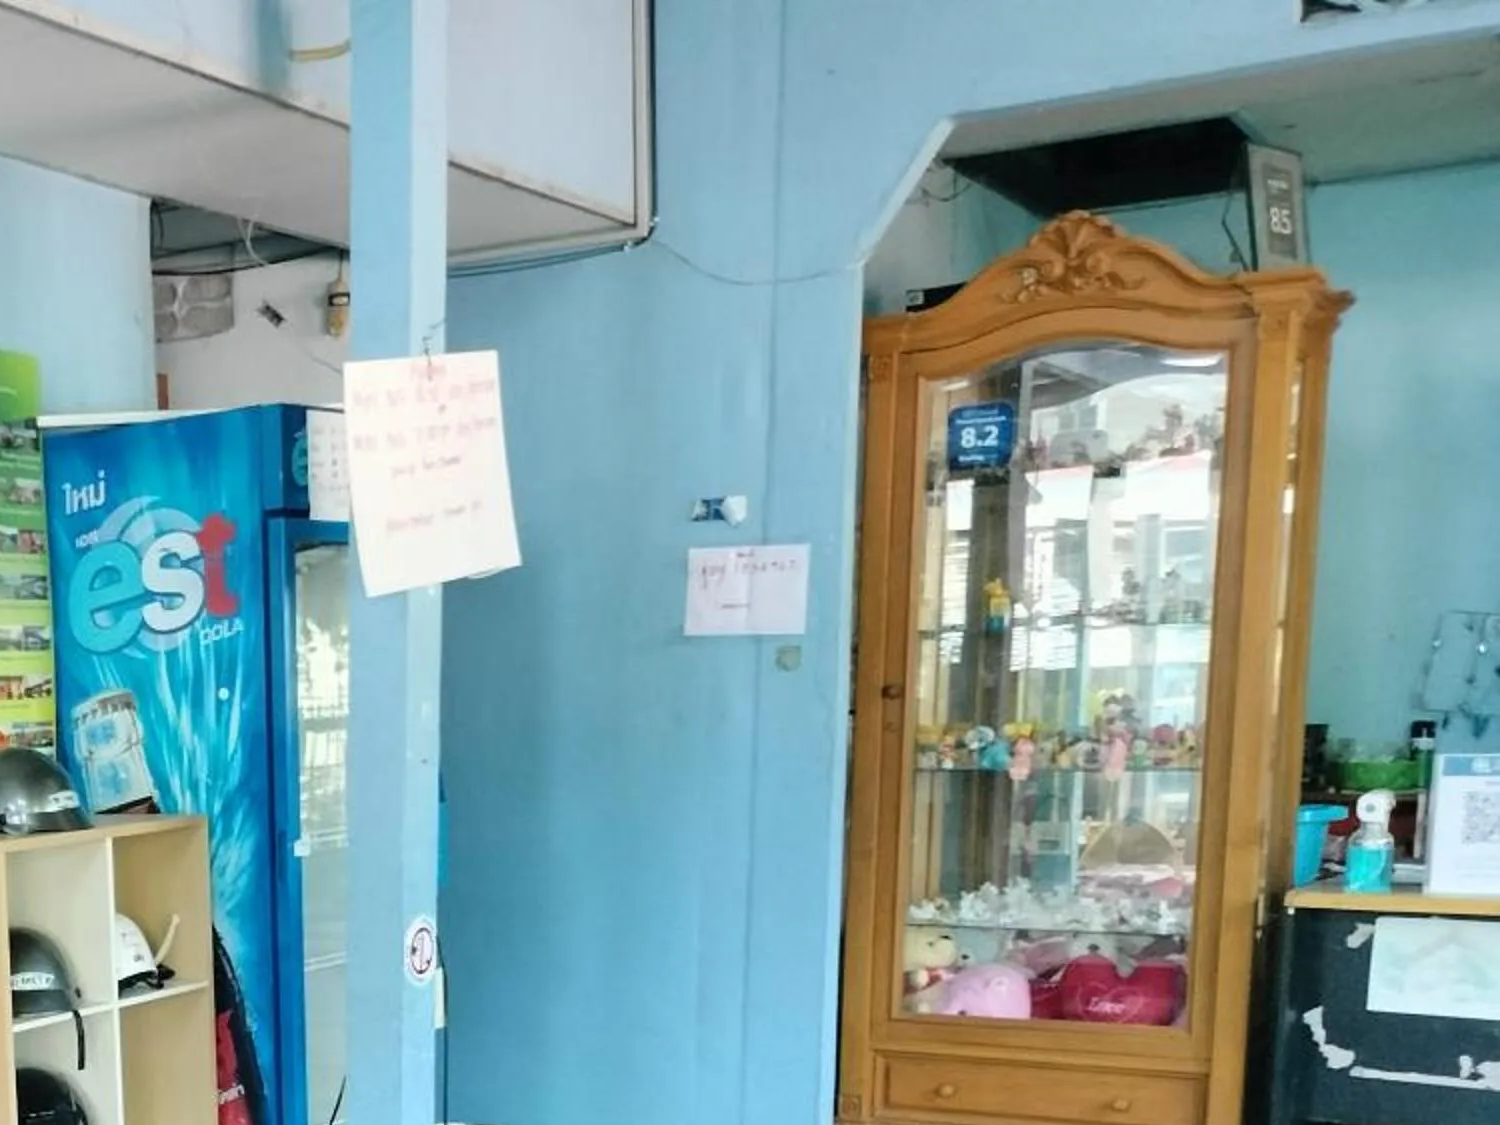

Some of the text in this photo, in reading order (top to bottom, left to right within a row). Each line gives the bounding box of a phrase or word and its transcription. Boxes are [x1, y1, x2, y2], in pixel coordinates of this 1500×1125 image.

[961, 425, 999, 449] 8.2
[61, 469, 105, 515] ใหม่
[68, 511, 241, 654] est
